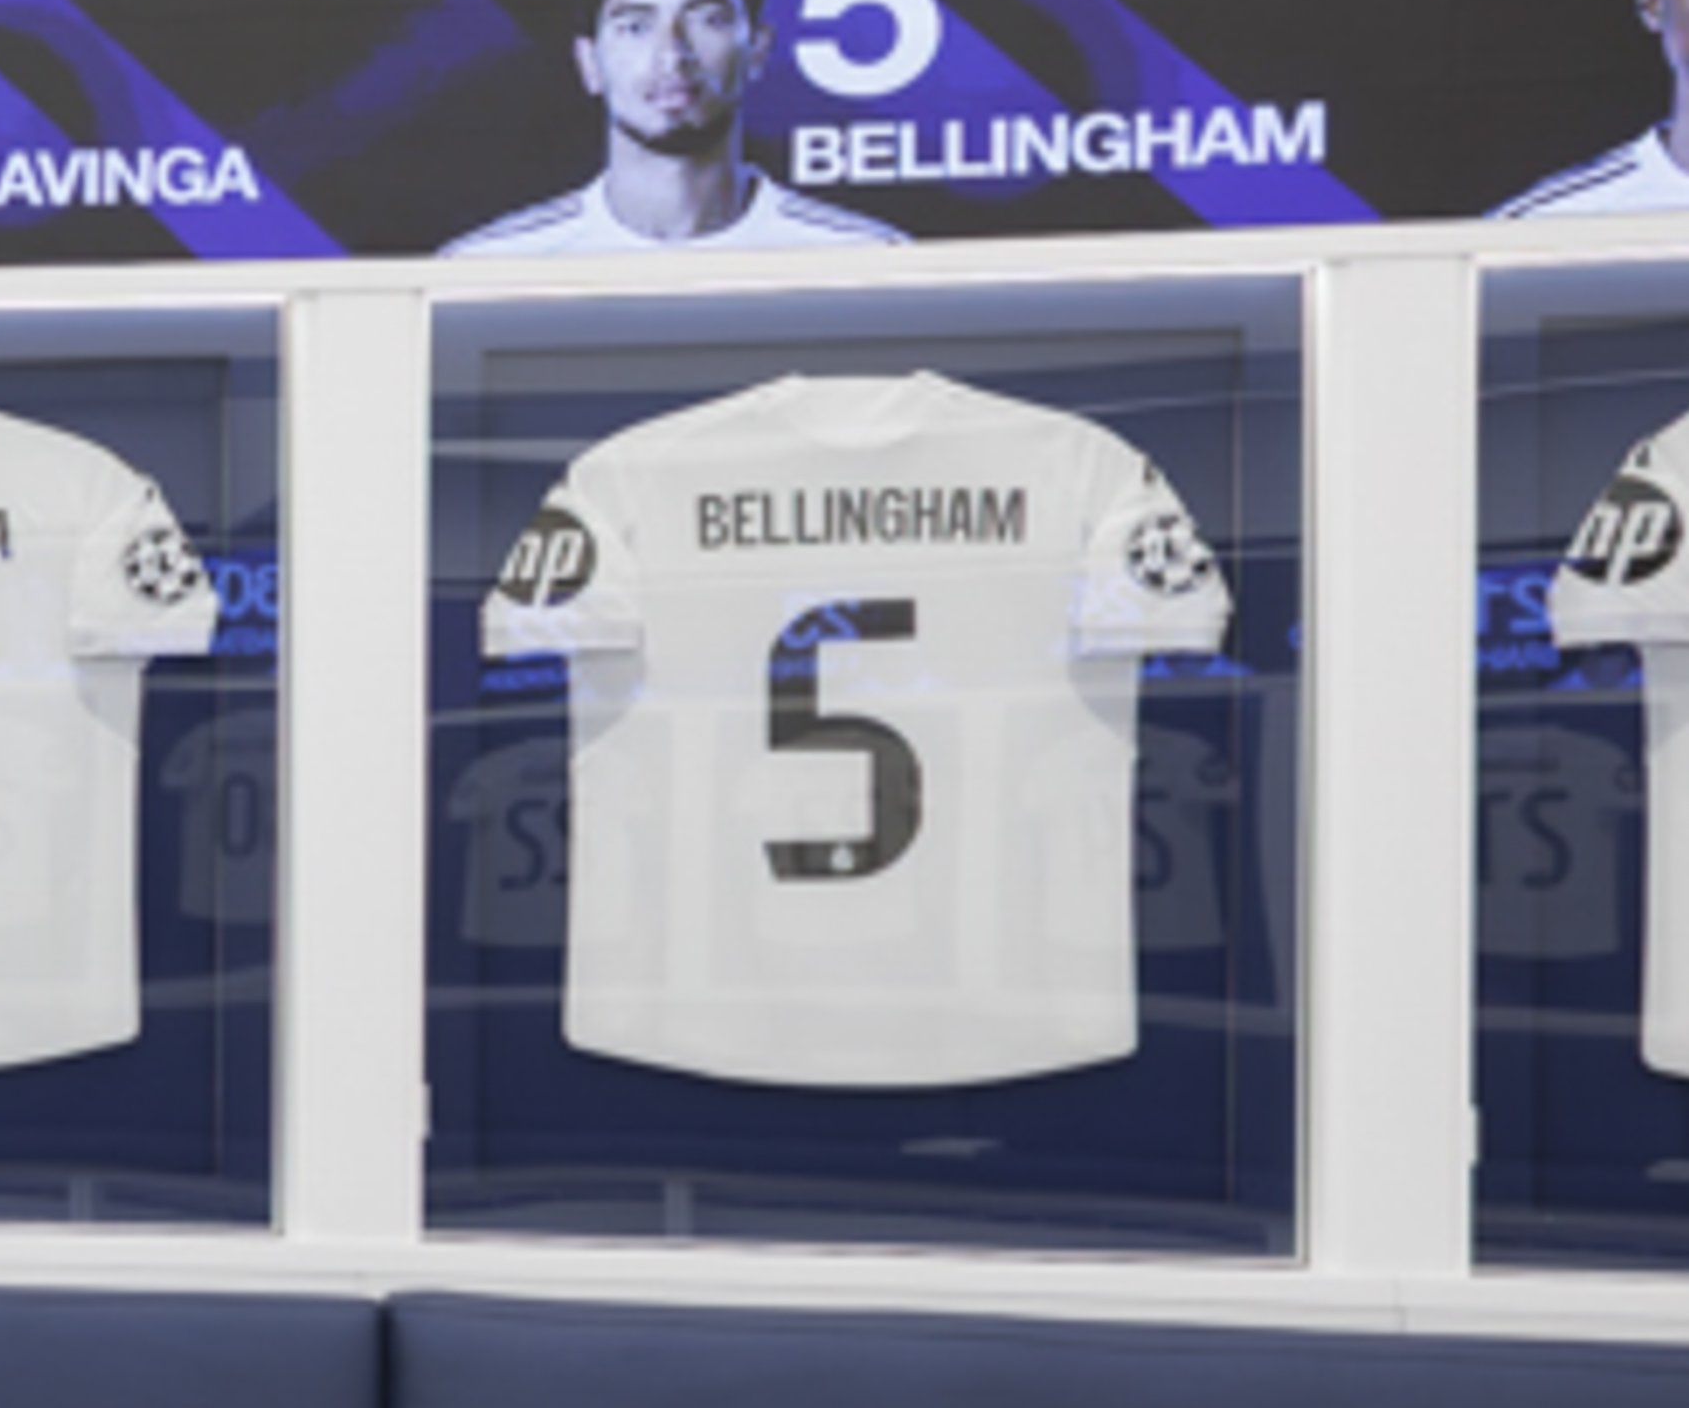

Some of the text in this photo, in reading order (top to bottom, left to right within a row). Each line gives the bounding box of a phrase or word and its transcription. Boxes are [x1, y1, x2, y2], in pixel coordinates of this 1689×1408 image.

[791, 101, 1327, 187] BELLINGHAM
[697, 486, 1028, 550] BELLINGHAM
[763, 597, 924, 883] 5
